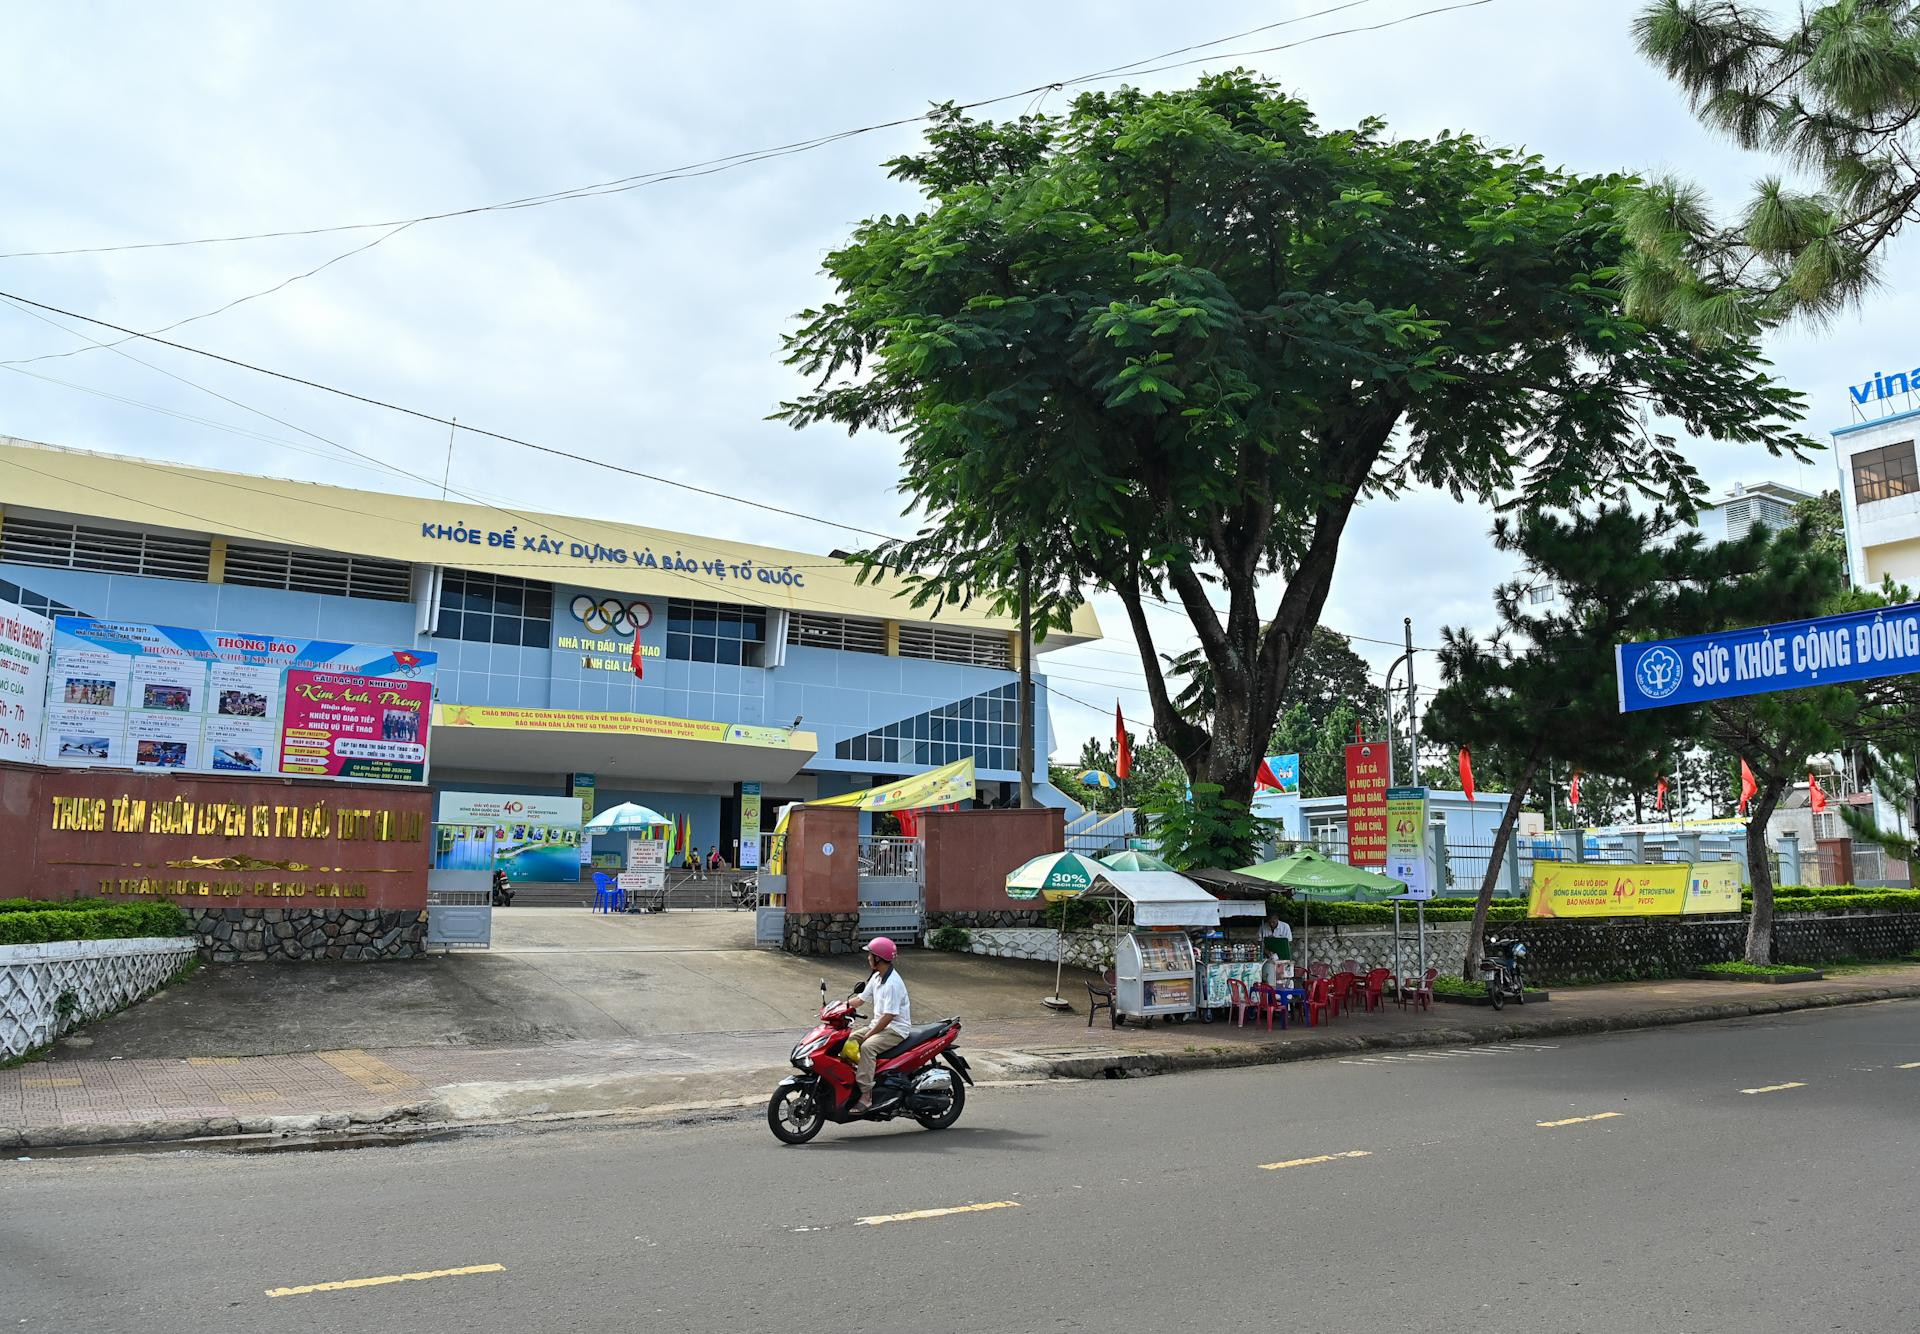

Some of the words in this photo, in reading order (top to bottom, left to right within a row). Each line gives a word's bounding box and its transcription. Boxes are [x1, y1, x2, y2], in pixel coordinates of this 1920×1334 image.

[422, 521, 481, 544] KHỎE
[488, 526, 517, 548] ĐỂ
[523, 534, 564, 554] XÂY
[571, 543, 627, 564] DỰNG
[633, 547, 658, 568] VÀ
[662, 551, 698, 573] BẢO
[702, 559, 726, 580] VỆ
[730, 560, 752, 580] TỔ
[757, 566, 804, 587] QUỐC
[217, 636, 264, 651] THÔNG
[269, 640, 296, 654] BÁO
[558, 636, 578, 650] NHÀ
[581, 639, 595, 650] THI
[597, 638, 616, 653] ĐẤU
[1693, 642, 1729, 687] SỨC
[1734, 629, 1787, 681] KHỎE
[1792, 626, 1850, 678] CỘNG
[1856, 611, 1919, 664] ĐỒNG
[582, 654, 602, 669] TNH
[604, 660, 620, 672] GIA
[622, 662, 637, 673] LA
[10, 680, 24, 696] CỬA
[295, 684, 334, 702] Kim
[378, 692, 422, 712] Phong
[14, 704, 24, 722] 7h
[361, 714, 375, 724] TIẾP
[356, 725, 372, 733] THAO
[17, 732, 30, 750] 19h
[1356, 763, 1367, 774] TẤT
[1350, 778, 1356, 788] VÌ
[1357, 779, 1371, 789] MỤC
[1372, 777, 1386, 787] TIÊU
[1352, 792, 1366, 802] DÂN
[504, 801, 523, 814] 40
[1350, 806, 1366, 817] NƯỚC
[52, 796, 106, 832] TRUNG
[112, 794, 146, 832] TÂM
[150, 792, 194, 834] HUẤN
[197, 799, 246, 840] LUYỆN
[275, 805, 298, 838] THI
[302, 800, 331, 838] ĐẤU
[337, 808, 371, 841] TDTT
[374, 810, 396, 842] GIA
[400, 810, 424, 842] LAI
[744, 808, 758, 820] 40
[1355, 821, 1366, 832] DÂN
[1396, 820, 1416, 837] 40
[1351, 835, 1366, 846] CÔNG
[1353, 849, 1366, 860] VĂN
[1052, 873, 1086, 884] 30%
[1594, 880, 1608, 888] ĐỊCH
[119, 874, 162, 895] TRẦN
[166, 880, 208, 896] HƯNG
[254, 883, 306, 898] PLEIKU
[316, 883, 340, 898] GIA
[344, 884, 368, 898] LAI
[1554, 888, 1570, 896] BÓNG
[1570, 888, 1581, 896] BÀN
[1583, 888, 1598, 896] QUỐC
[1613, 878, 1636, 904] 40
[1579, 898, 1594, 906] NHÂN
